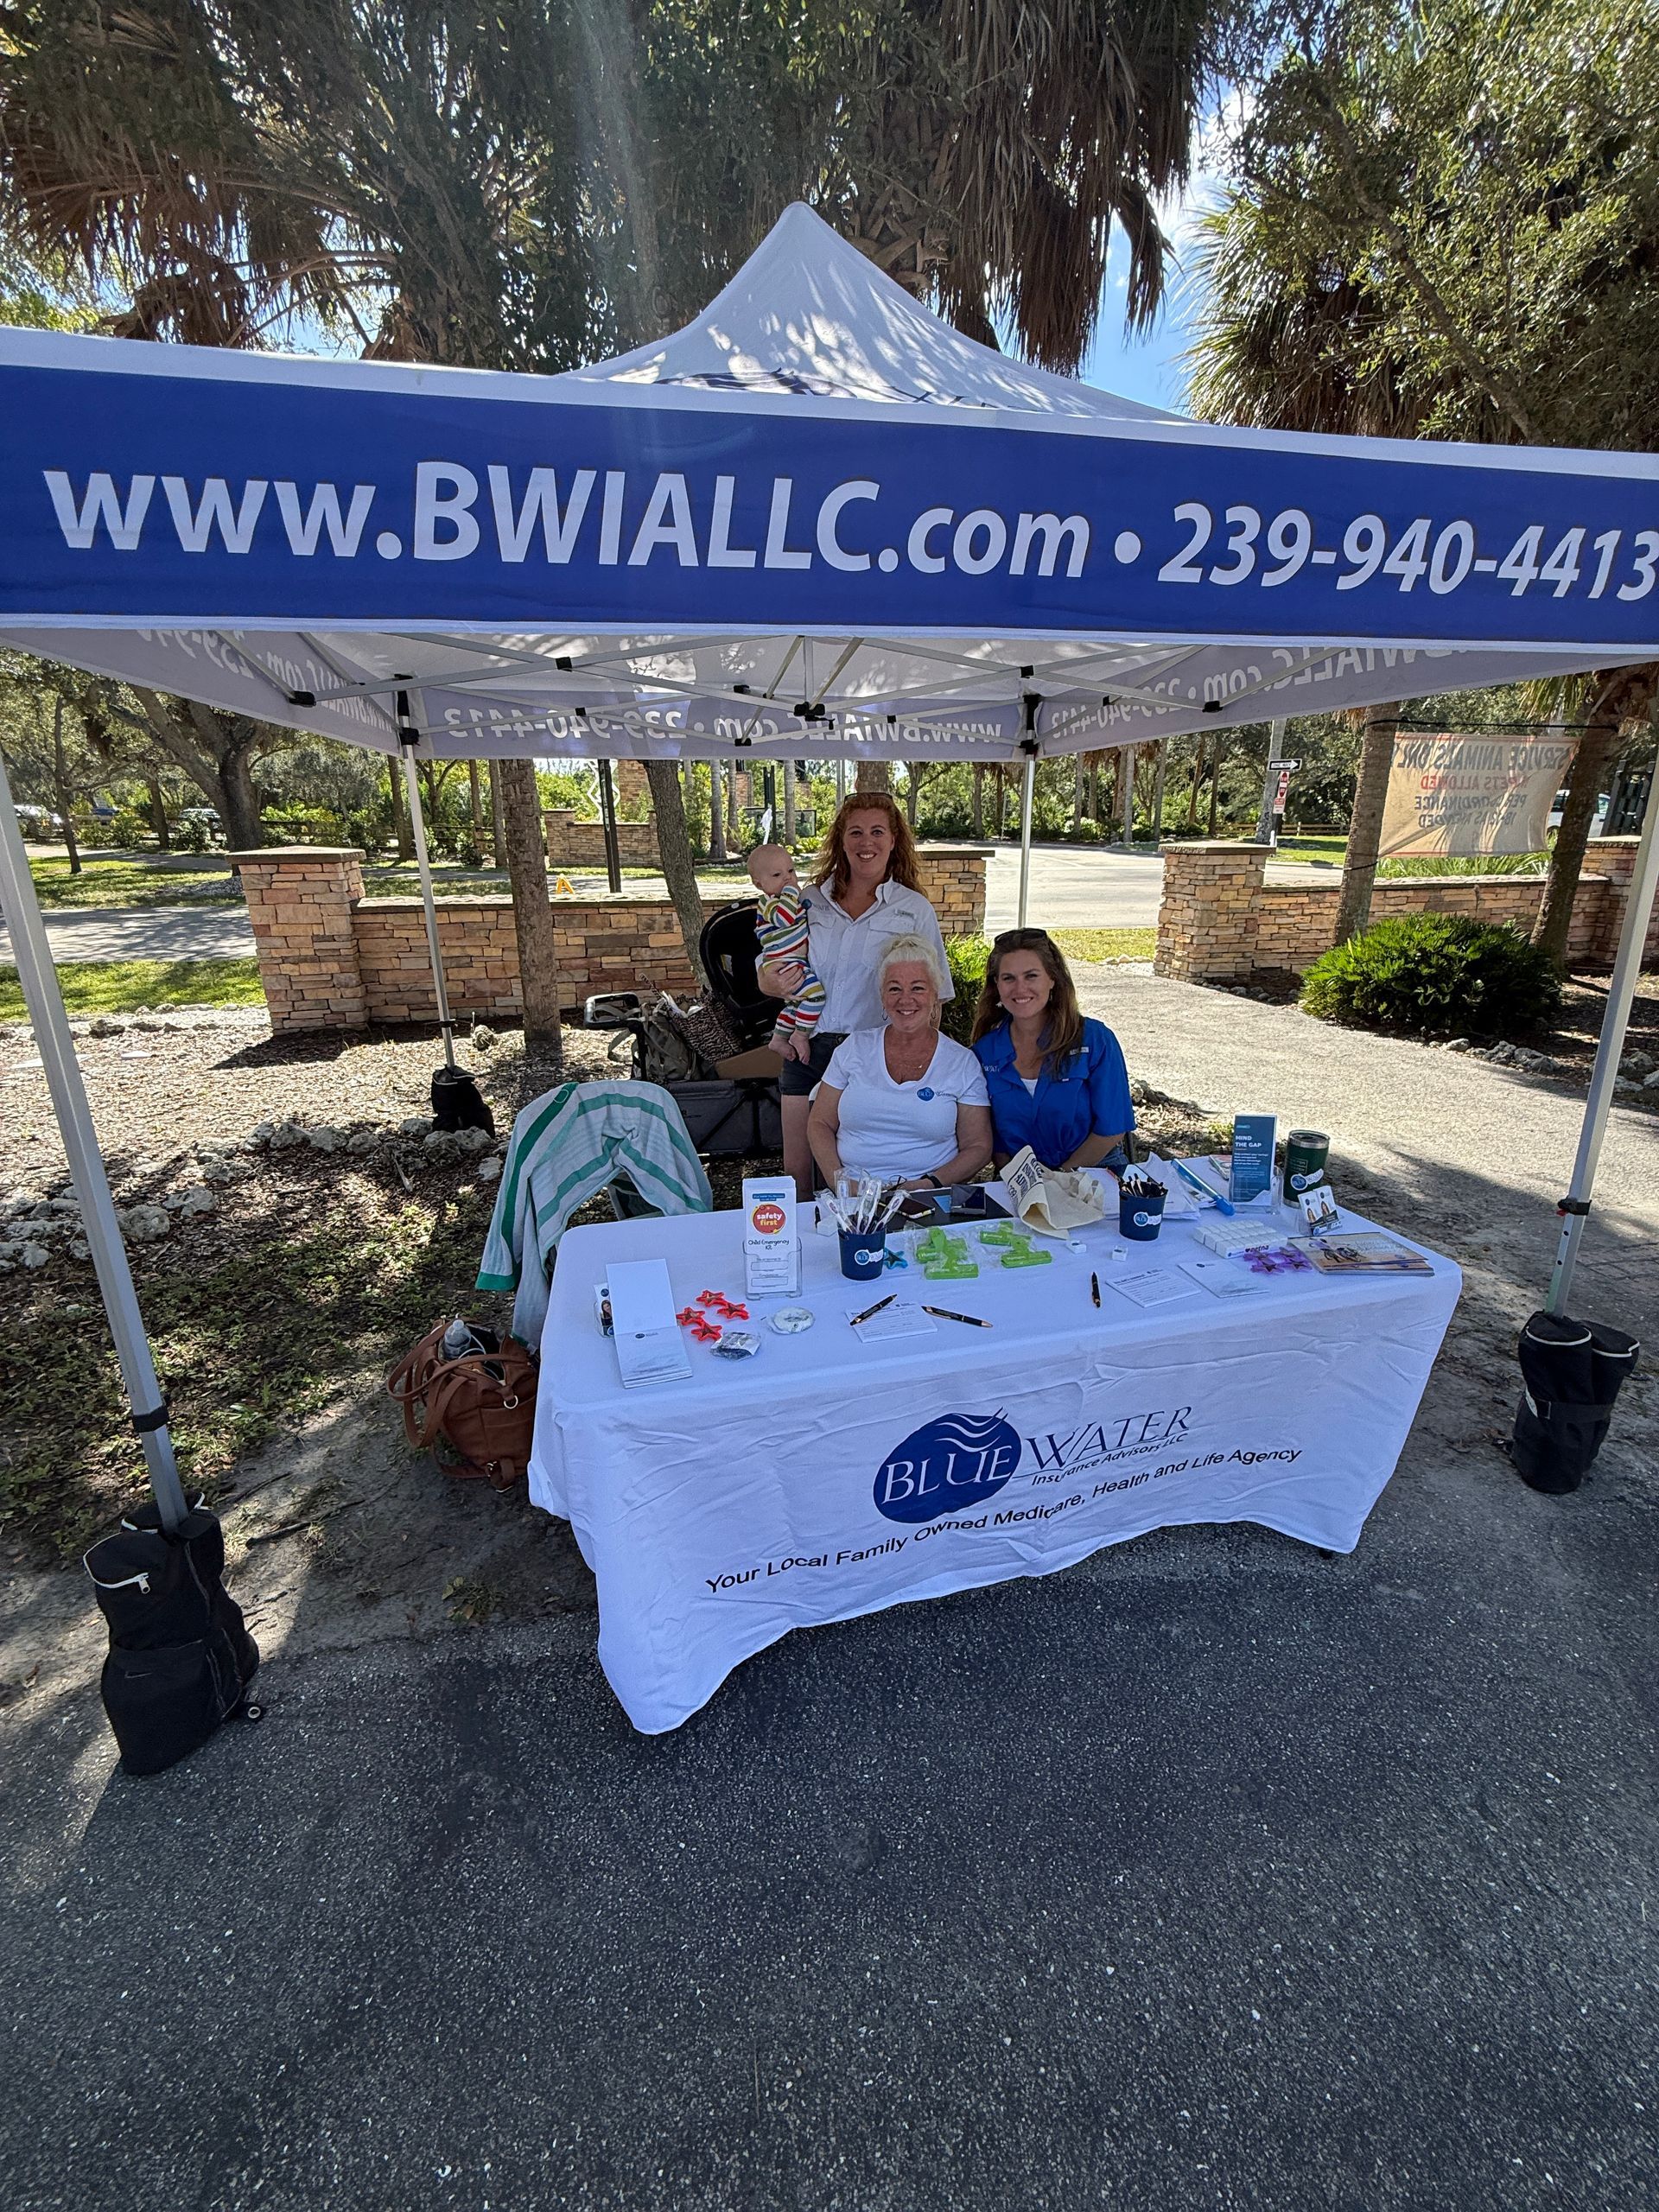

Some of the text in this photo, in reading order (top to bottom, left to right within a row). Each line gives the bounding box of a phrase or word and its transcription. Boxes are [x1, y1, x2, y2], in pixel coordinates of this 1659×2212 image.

[43, 461, 1659, 601] www.BWIALLC.com 239-940-4413
[757, 1212, 782, 1221] safety
[881, 1406, 1192, 1504] BLUE WATER
[1032, 1433, 1189, 1485] Insurance Advisors LLC
[705, 1447, 1302, 1593] Your Local Family Owned Medicare, Health and Life Agency
